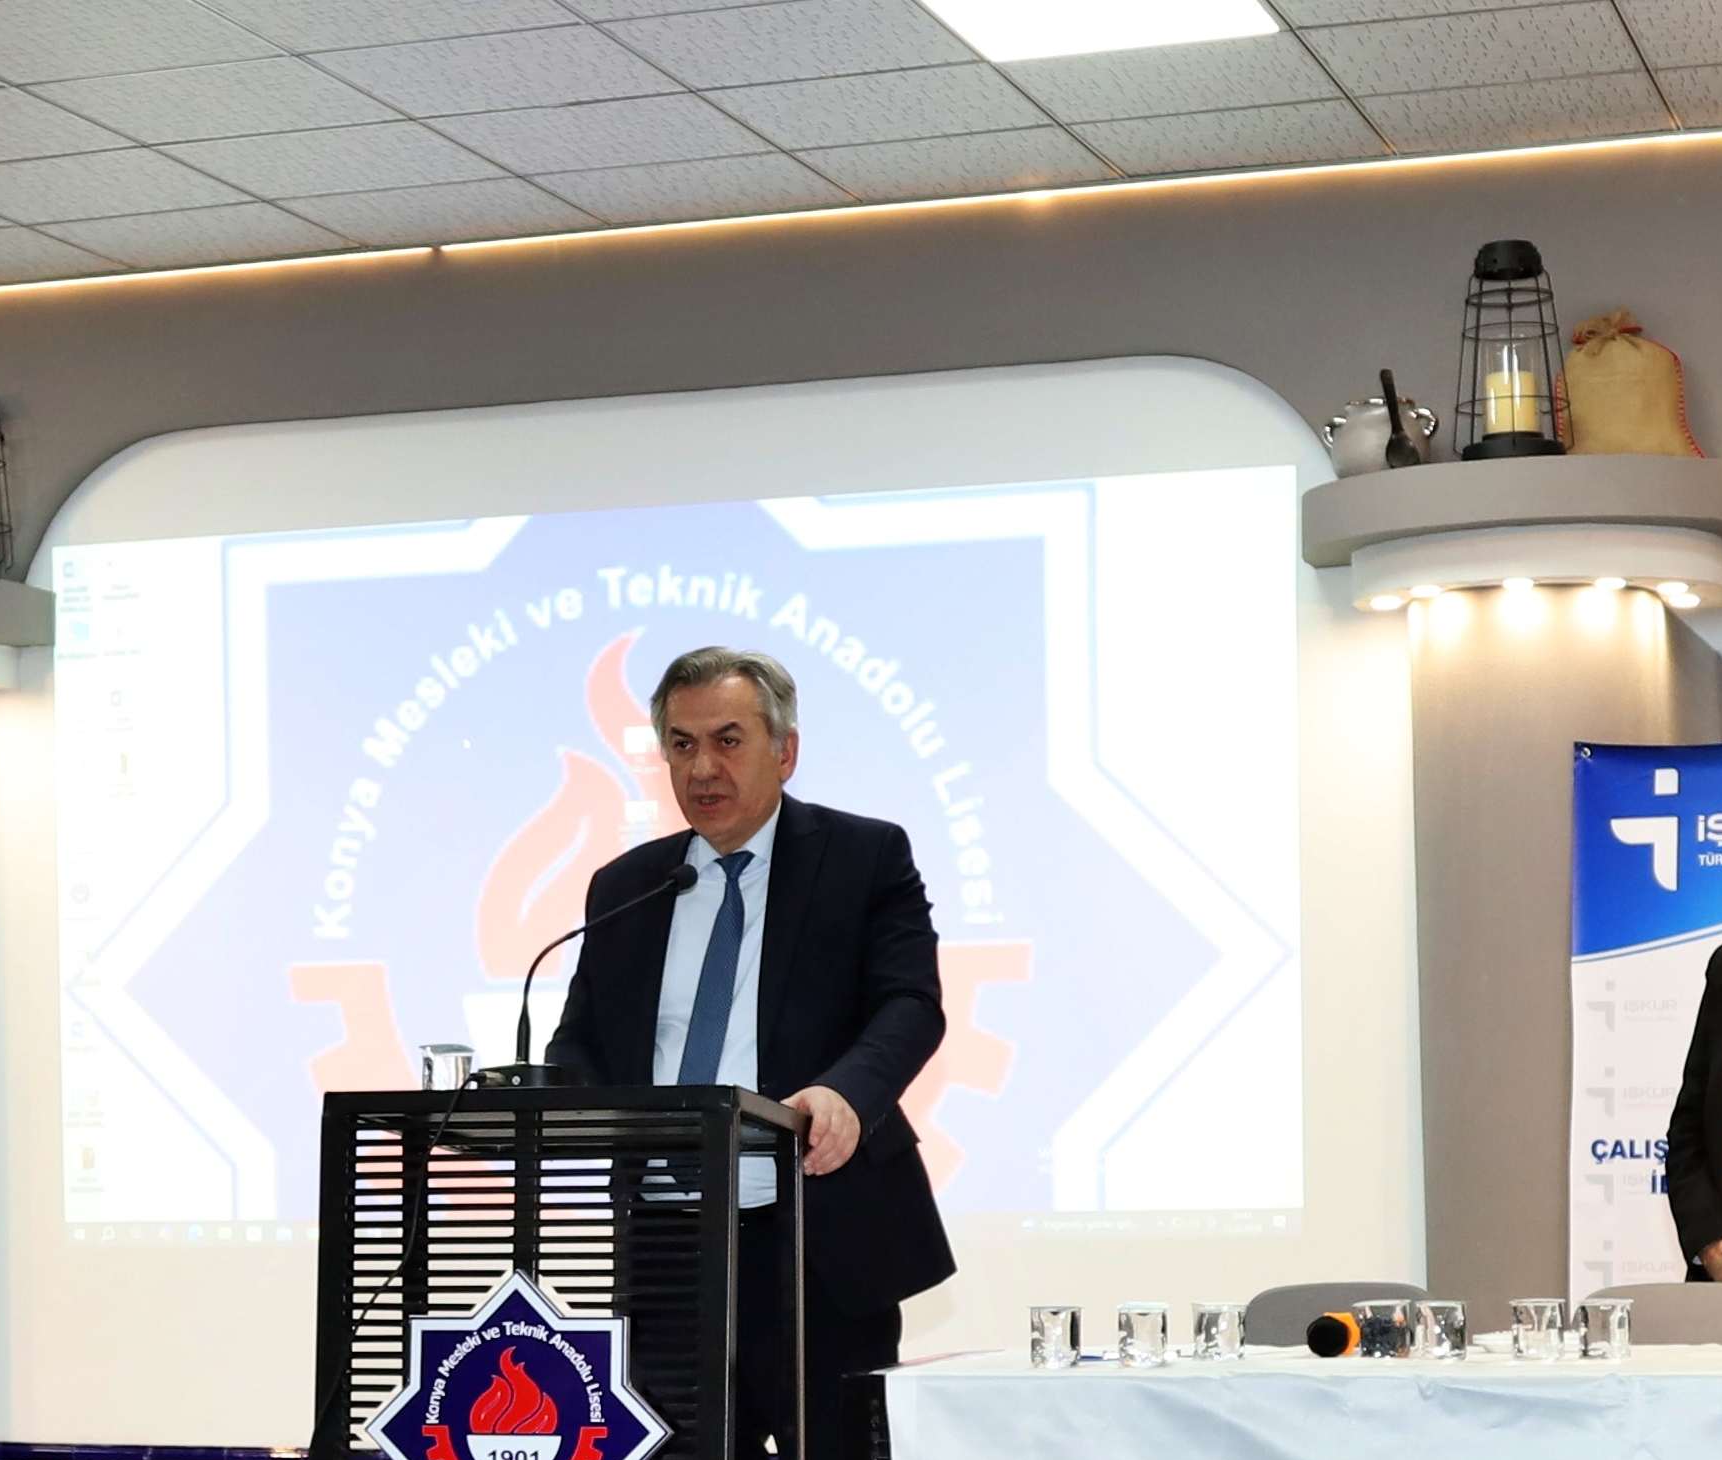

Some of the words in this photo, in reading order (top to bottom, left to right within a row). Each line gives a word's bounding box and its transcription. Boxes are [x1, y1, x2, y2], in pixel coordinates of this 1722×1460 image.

[313, 780, 381, 939] Konya
[362, 609, 520, 768] Mesleki
[526, 585, 584, 629] ve
[597, 565, 765, 621] Teknik
[771, 592, 946, 760] Anadolu
[931, 759, 1006, 926] Lisesi
[1590, 1138, 1669, 1165] ÇALIŞ
[425, 1377, 447, 1424] Konya
[438, 1331, 481, 1377] Mesleki
[482, 1326, 501, 1340] ve
[502, 1320, 550, 1343] Teknik
[548, 1333, 593, 1383] Anadolu
[586, 1382, 605, 1423] Lisesi
